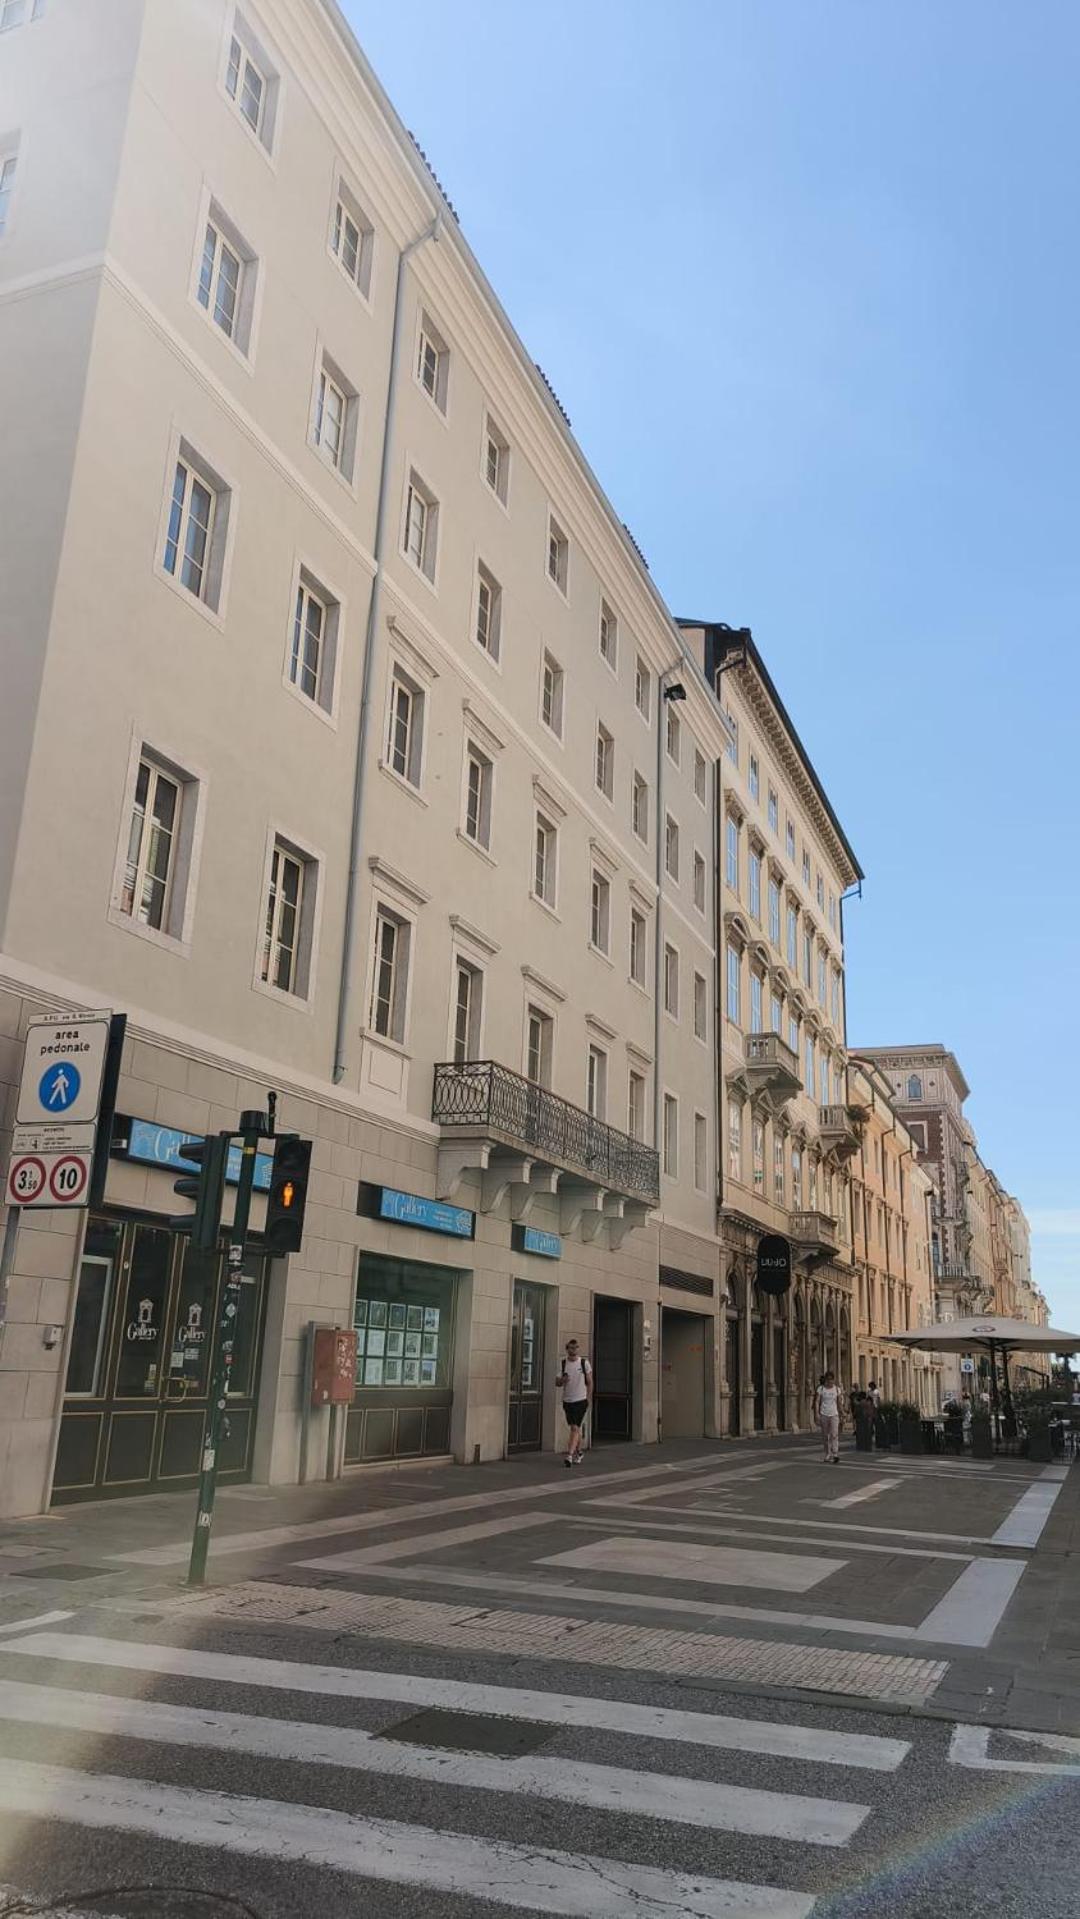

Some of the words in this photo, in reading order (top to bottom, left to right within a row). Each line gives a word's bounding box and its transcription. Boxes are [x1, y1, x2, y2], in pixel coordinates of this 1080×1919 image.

[55, 1031, 79, 1040] area
[40, 1042, 91, 1056] pedonale
[59, 1168, 78, 1189] 10
[127, 1321, 159, 1340] Gallery
[178, 1326, 207, 1343] Gallery
